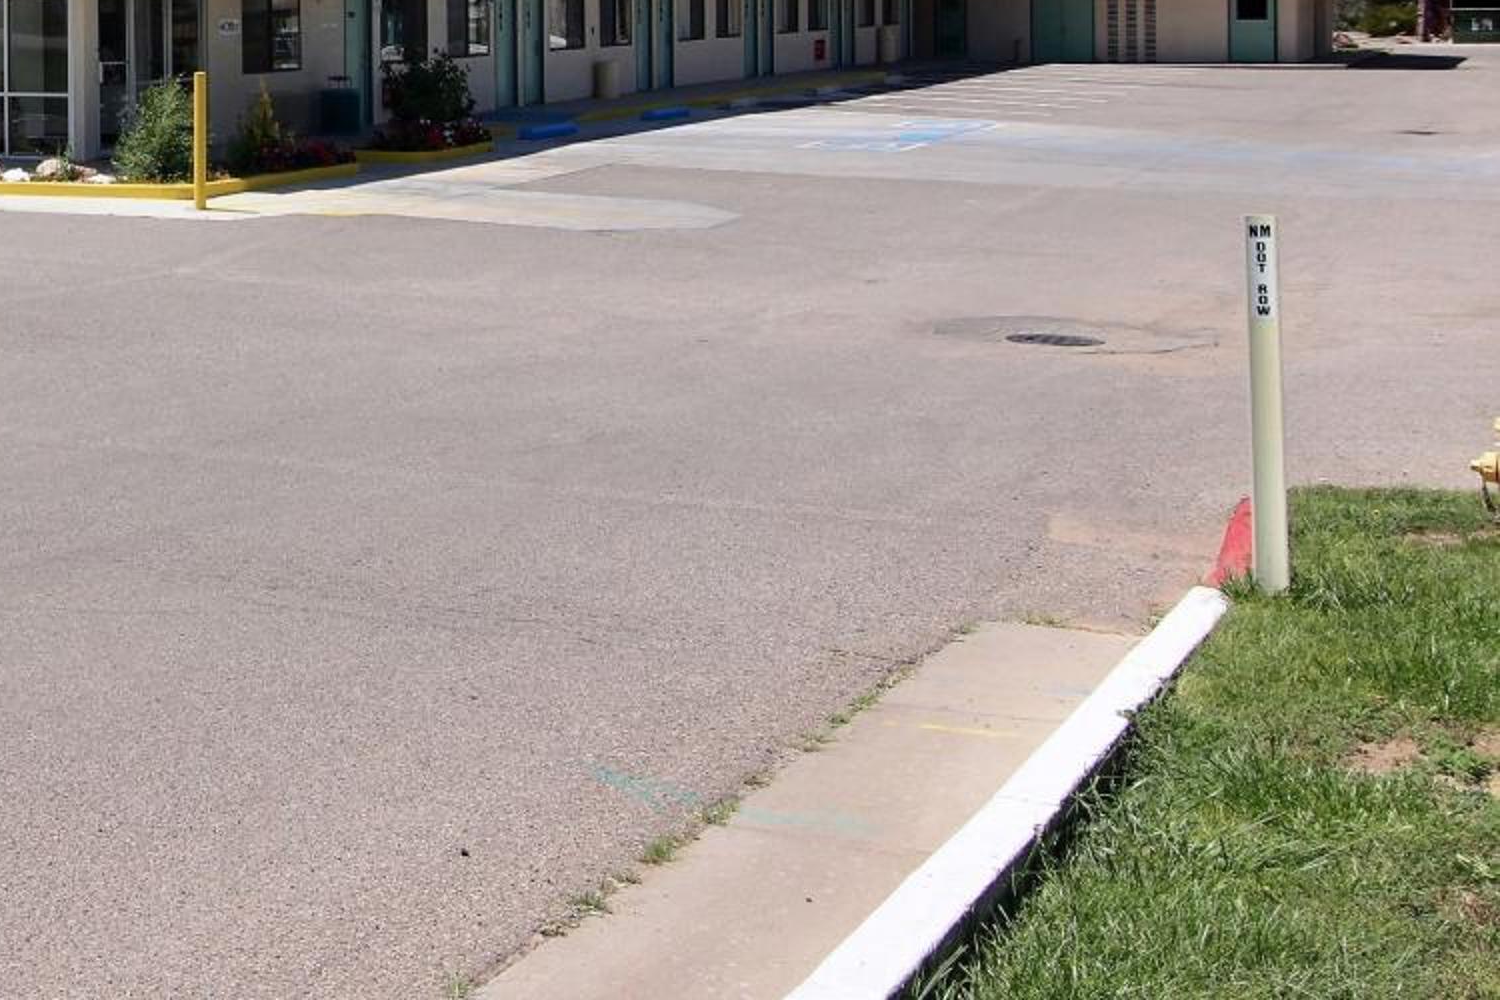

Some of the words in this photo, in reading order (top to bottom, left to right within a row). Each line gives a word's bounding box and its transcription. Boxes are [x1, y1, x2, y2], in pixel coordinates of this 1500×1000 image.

[1249, 224, 1271, 238] NM
[1256, 241, 1267, 273] DOT
[1256, 283, 1271, 316] ROW
